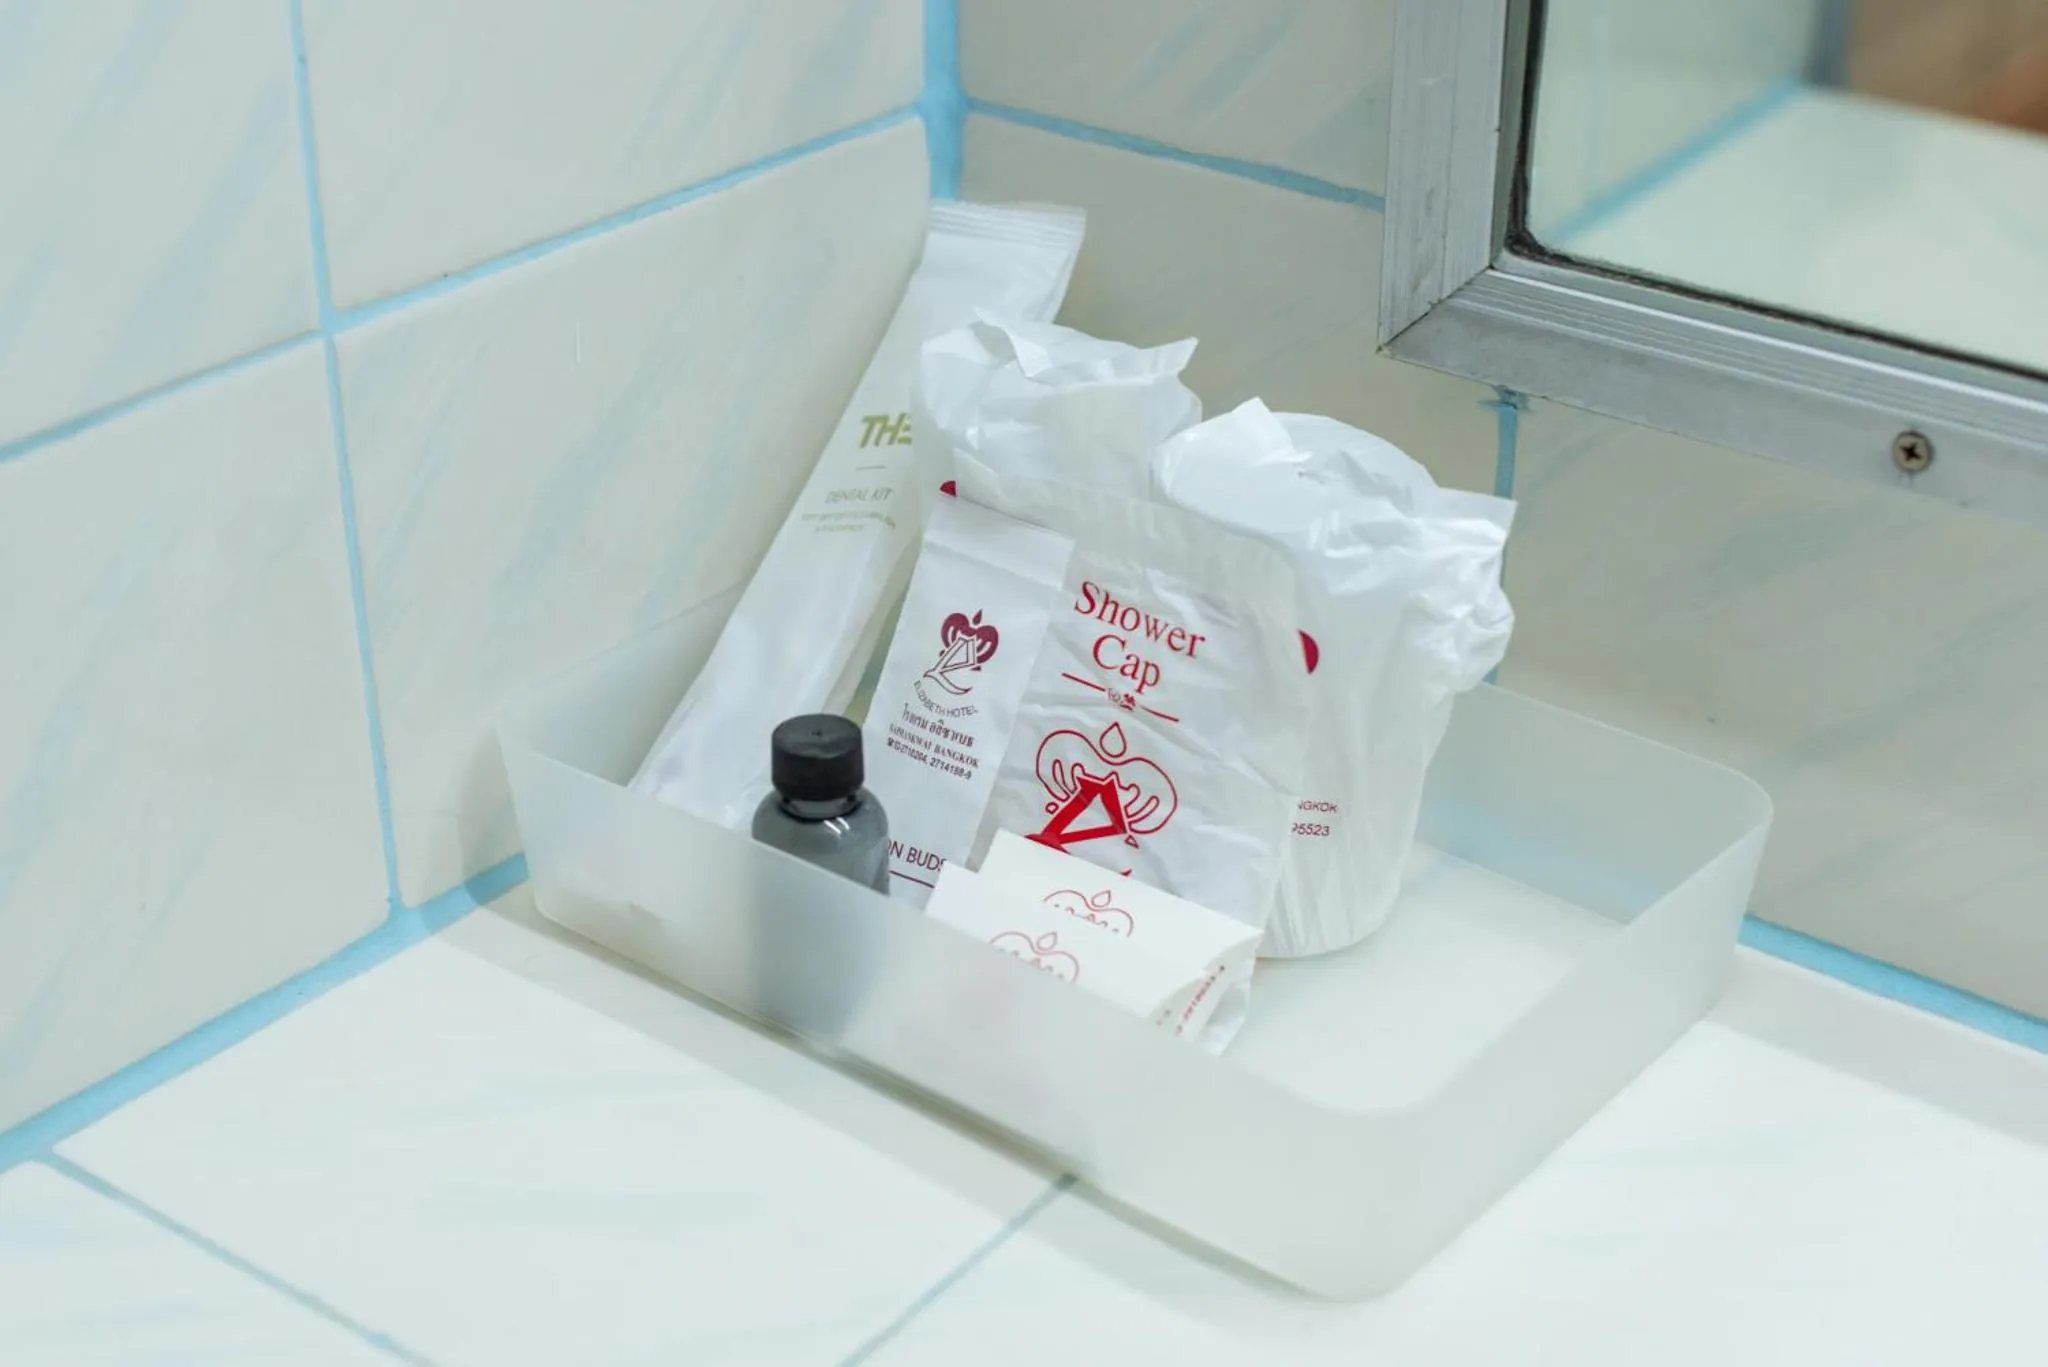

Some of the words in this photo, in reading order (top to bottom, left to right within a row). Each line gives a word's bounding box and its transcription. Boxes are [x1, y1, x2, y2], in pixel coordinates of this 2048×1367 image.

[1074, 581, 1205, 658] Shower
[1092, 635, 1160, 694] Cap
[946, 705, 979, 718] HOTEL
[934, 744, 980, 768] BANGKOK
